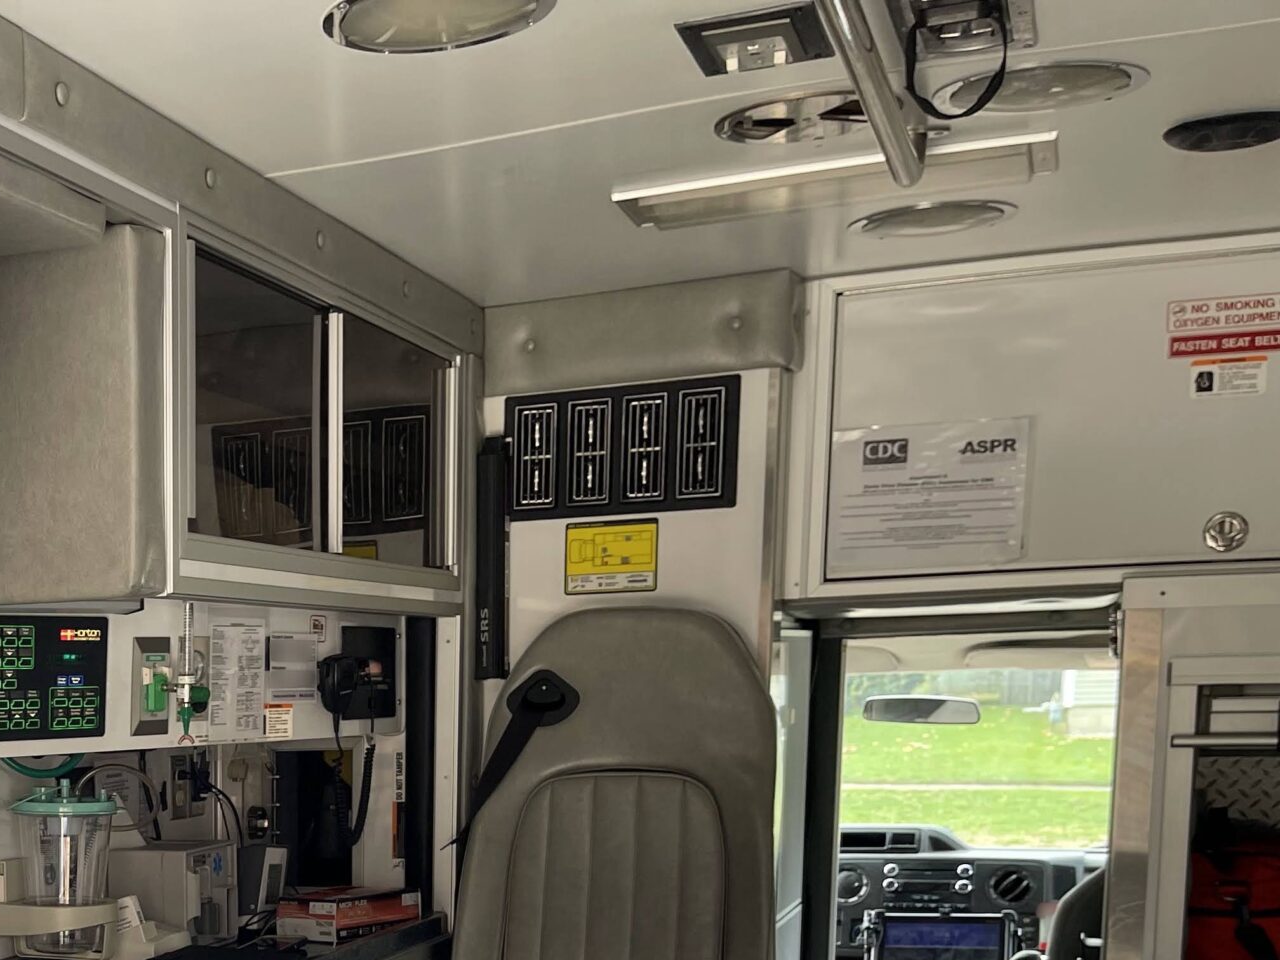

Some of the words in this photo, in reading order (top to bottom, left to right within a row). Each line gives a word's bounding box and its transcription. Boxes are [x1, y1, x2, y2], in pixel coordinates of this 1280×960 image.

[1191, 304, 1209, 314] NO
[1215, 298, 1276, 312] SMOKING
[1173, 315, 1221, 329] OXYGEN
[1224, 311, 1280, 324] EQUIPME
[1173, 340, 1217, 353] FASTEN
[1221, 337, 1251, 349] SEAT
[864, 441, 908, 459] CDC
[959, 438, 1017, 455] ASPR
[480, 607, 489, 643] SRS
[395, 751, 403, 777] TAMPER
